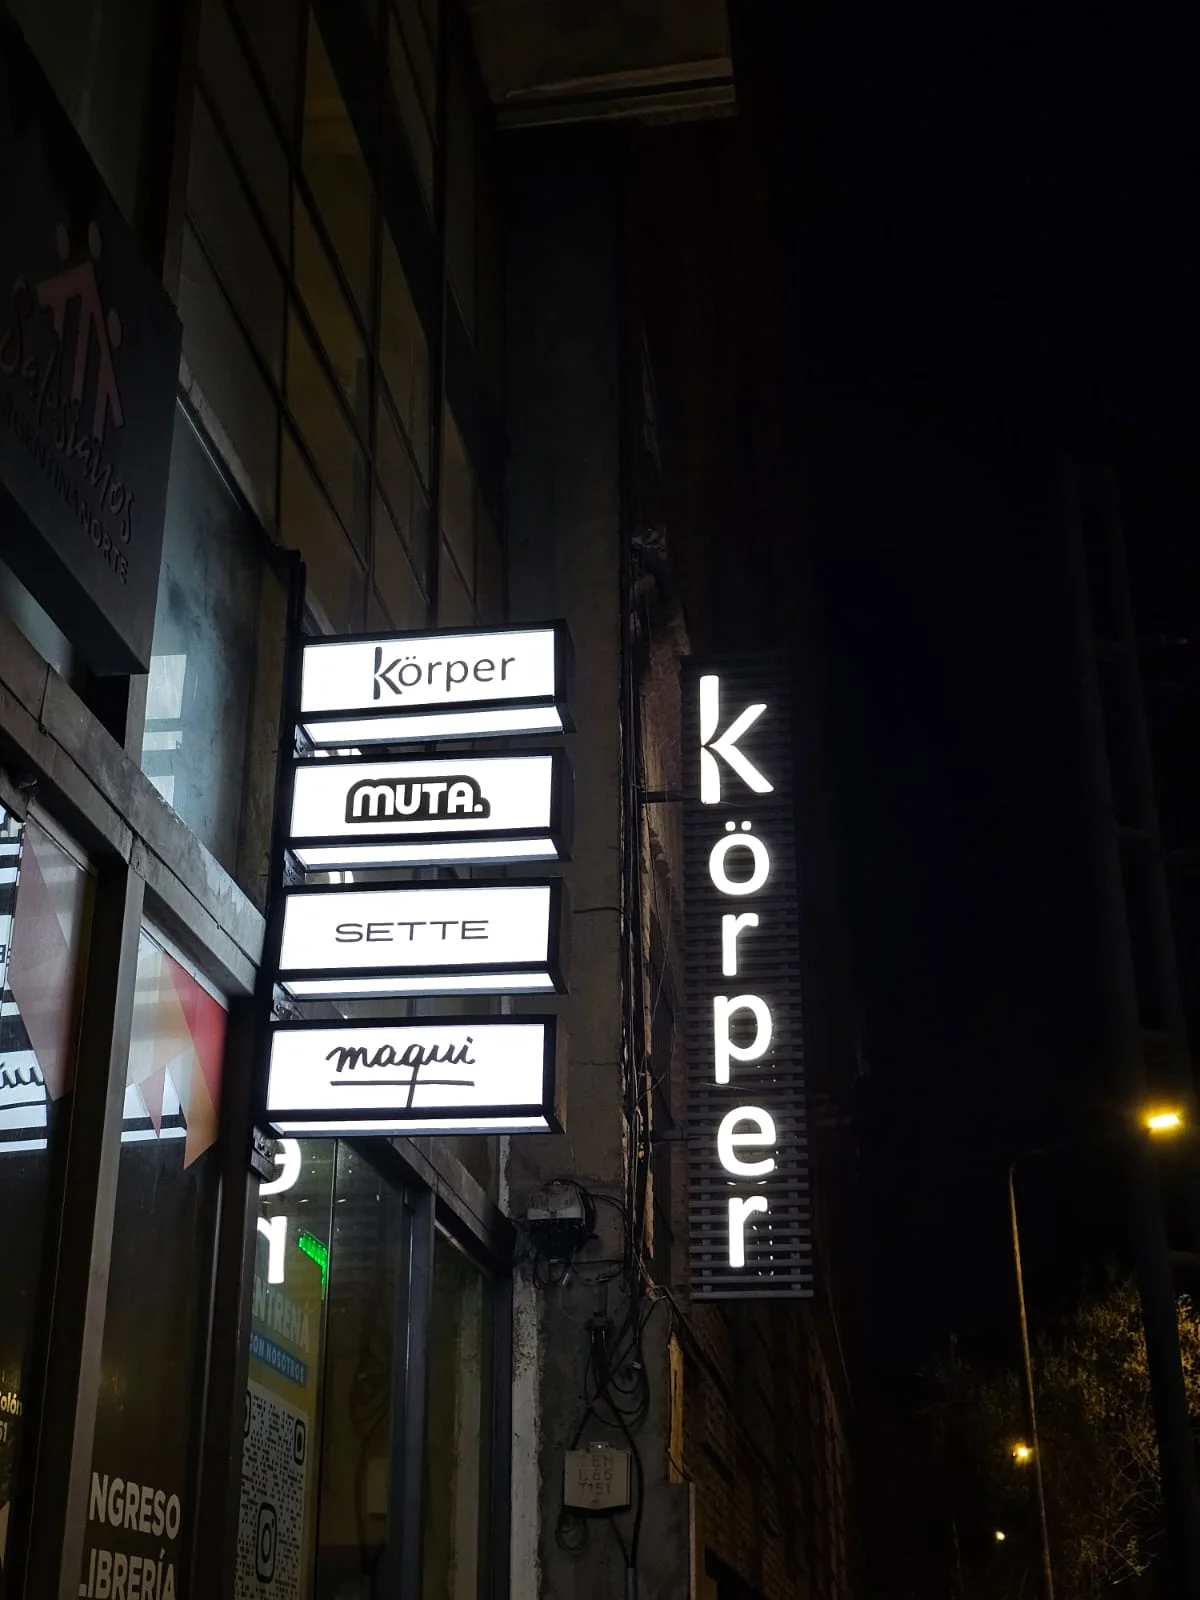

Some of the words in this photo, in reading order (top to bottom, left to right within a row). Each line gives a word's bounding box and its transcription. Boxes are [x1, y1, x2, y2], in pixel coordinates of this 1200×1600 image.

[335, 919, 489, 943] SETTE
[326, 1036, 476, 1109] maqui
[253, 1275, 310, 1354] NTRENA
[0, 1389, 23, 1416] olón
[88, 1471, 182, 1541] NGRESO
